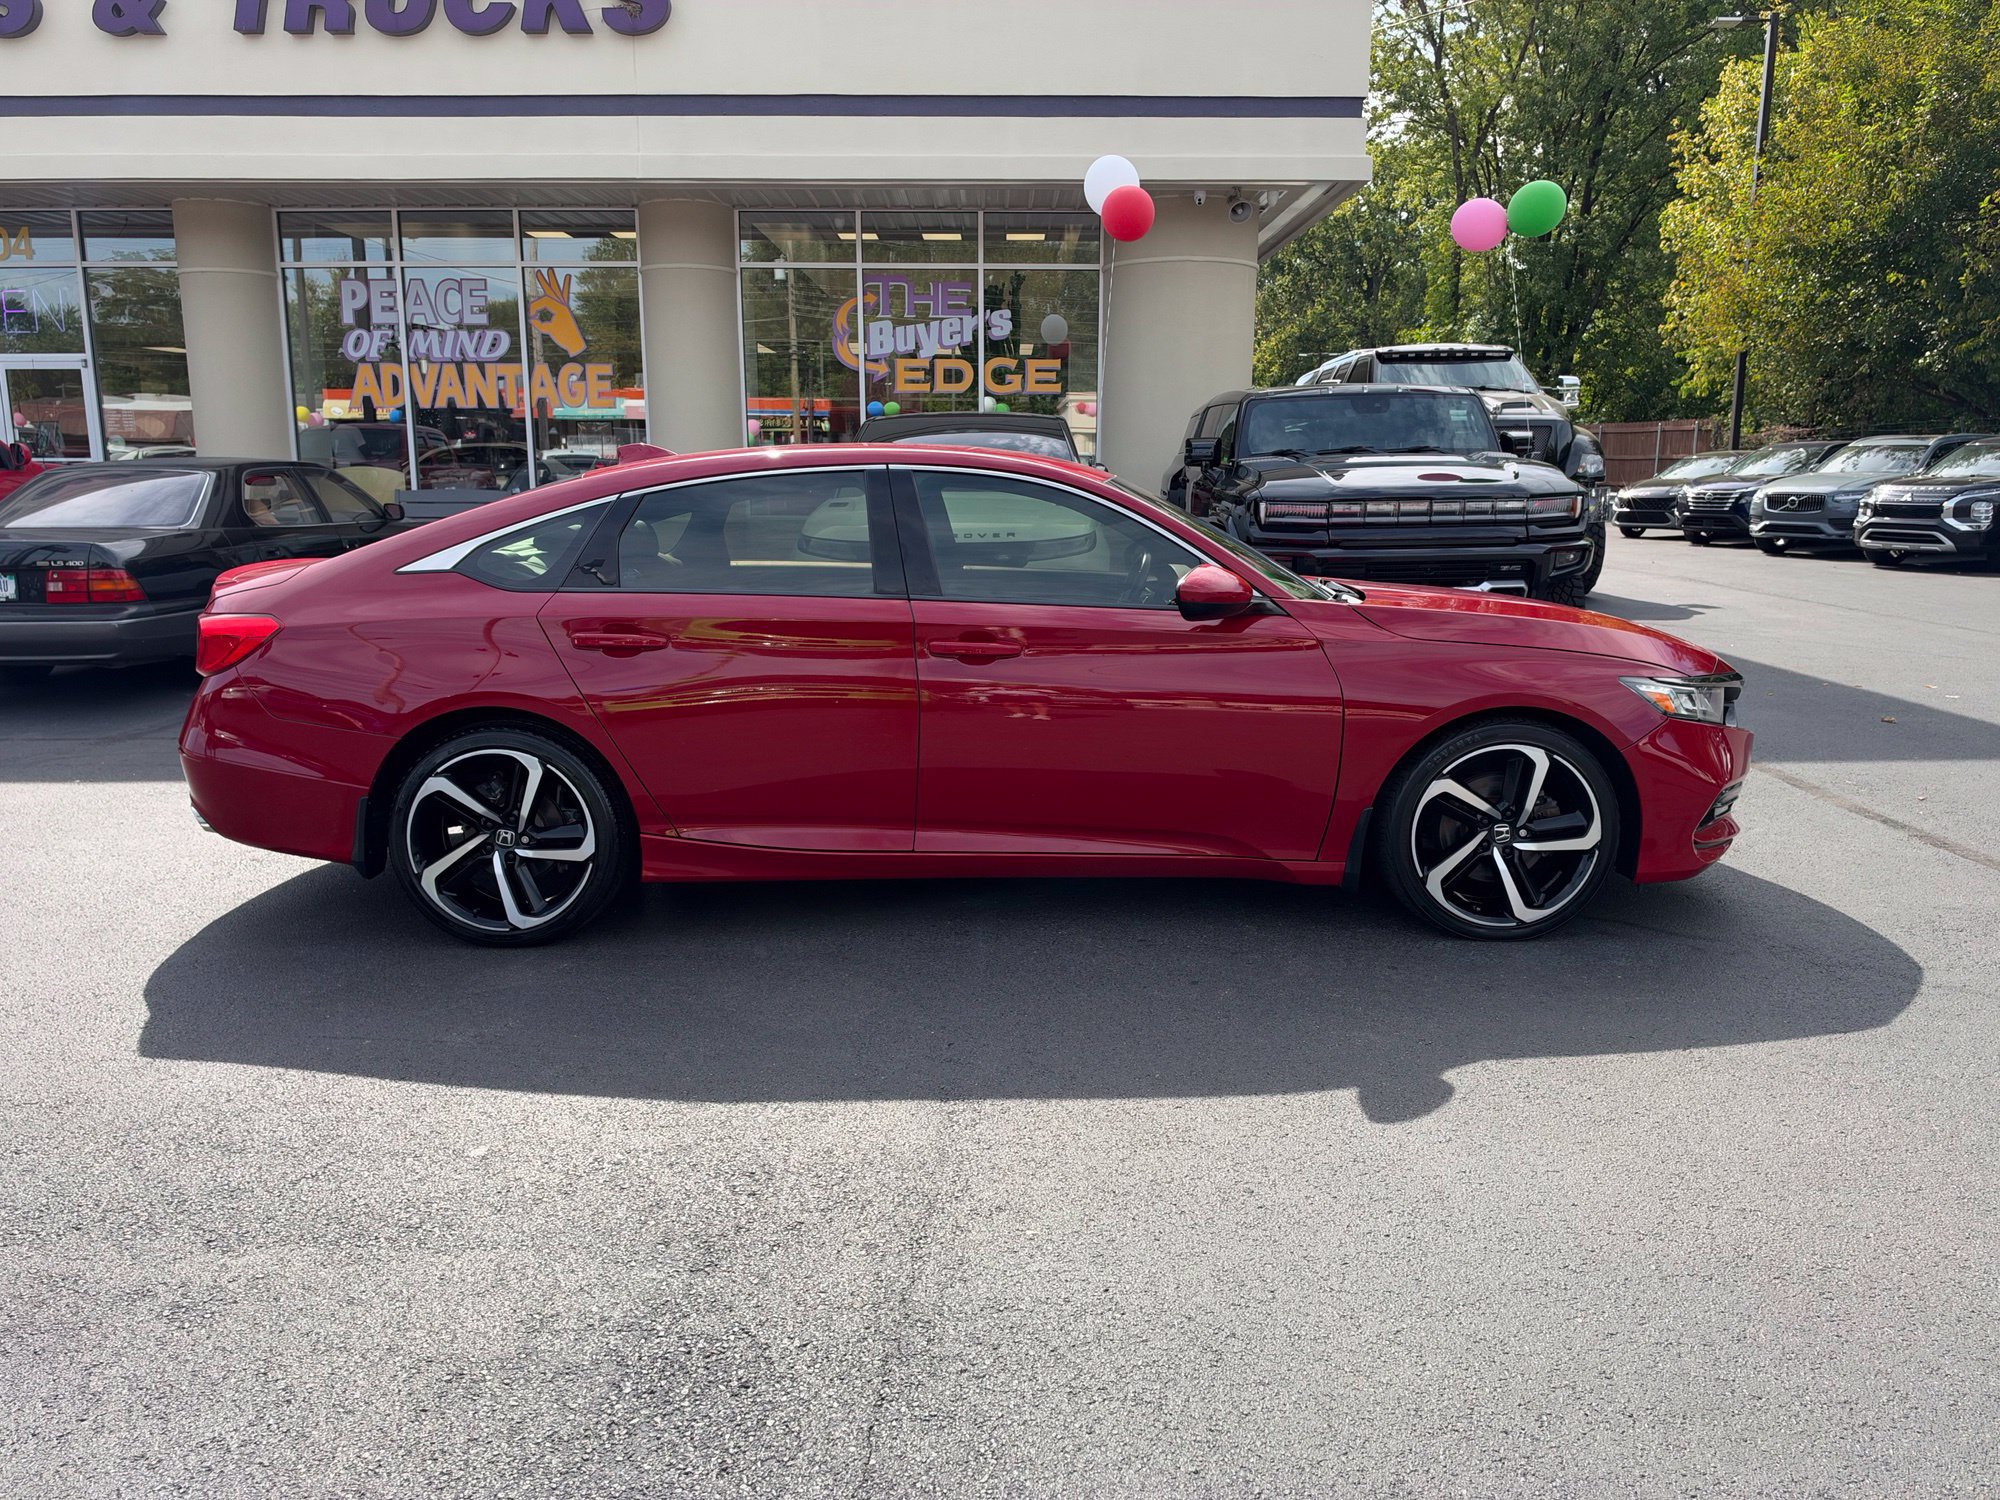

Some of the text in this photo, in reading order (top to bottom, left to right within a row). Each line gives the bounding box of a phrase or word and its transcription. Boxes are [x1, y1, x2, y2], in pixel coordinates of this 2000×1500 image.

[340, 278, 489, 326] PEACE
[863, 274, 973, 318] THE
[343, 329, 511, 362] OF MIND
[867, 308, 1013, 360] Buyer's
[350, 362, 617, 410] ADVANTAGE
[893, 357, 1062, 395] EDGE
